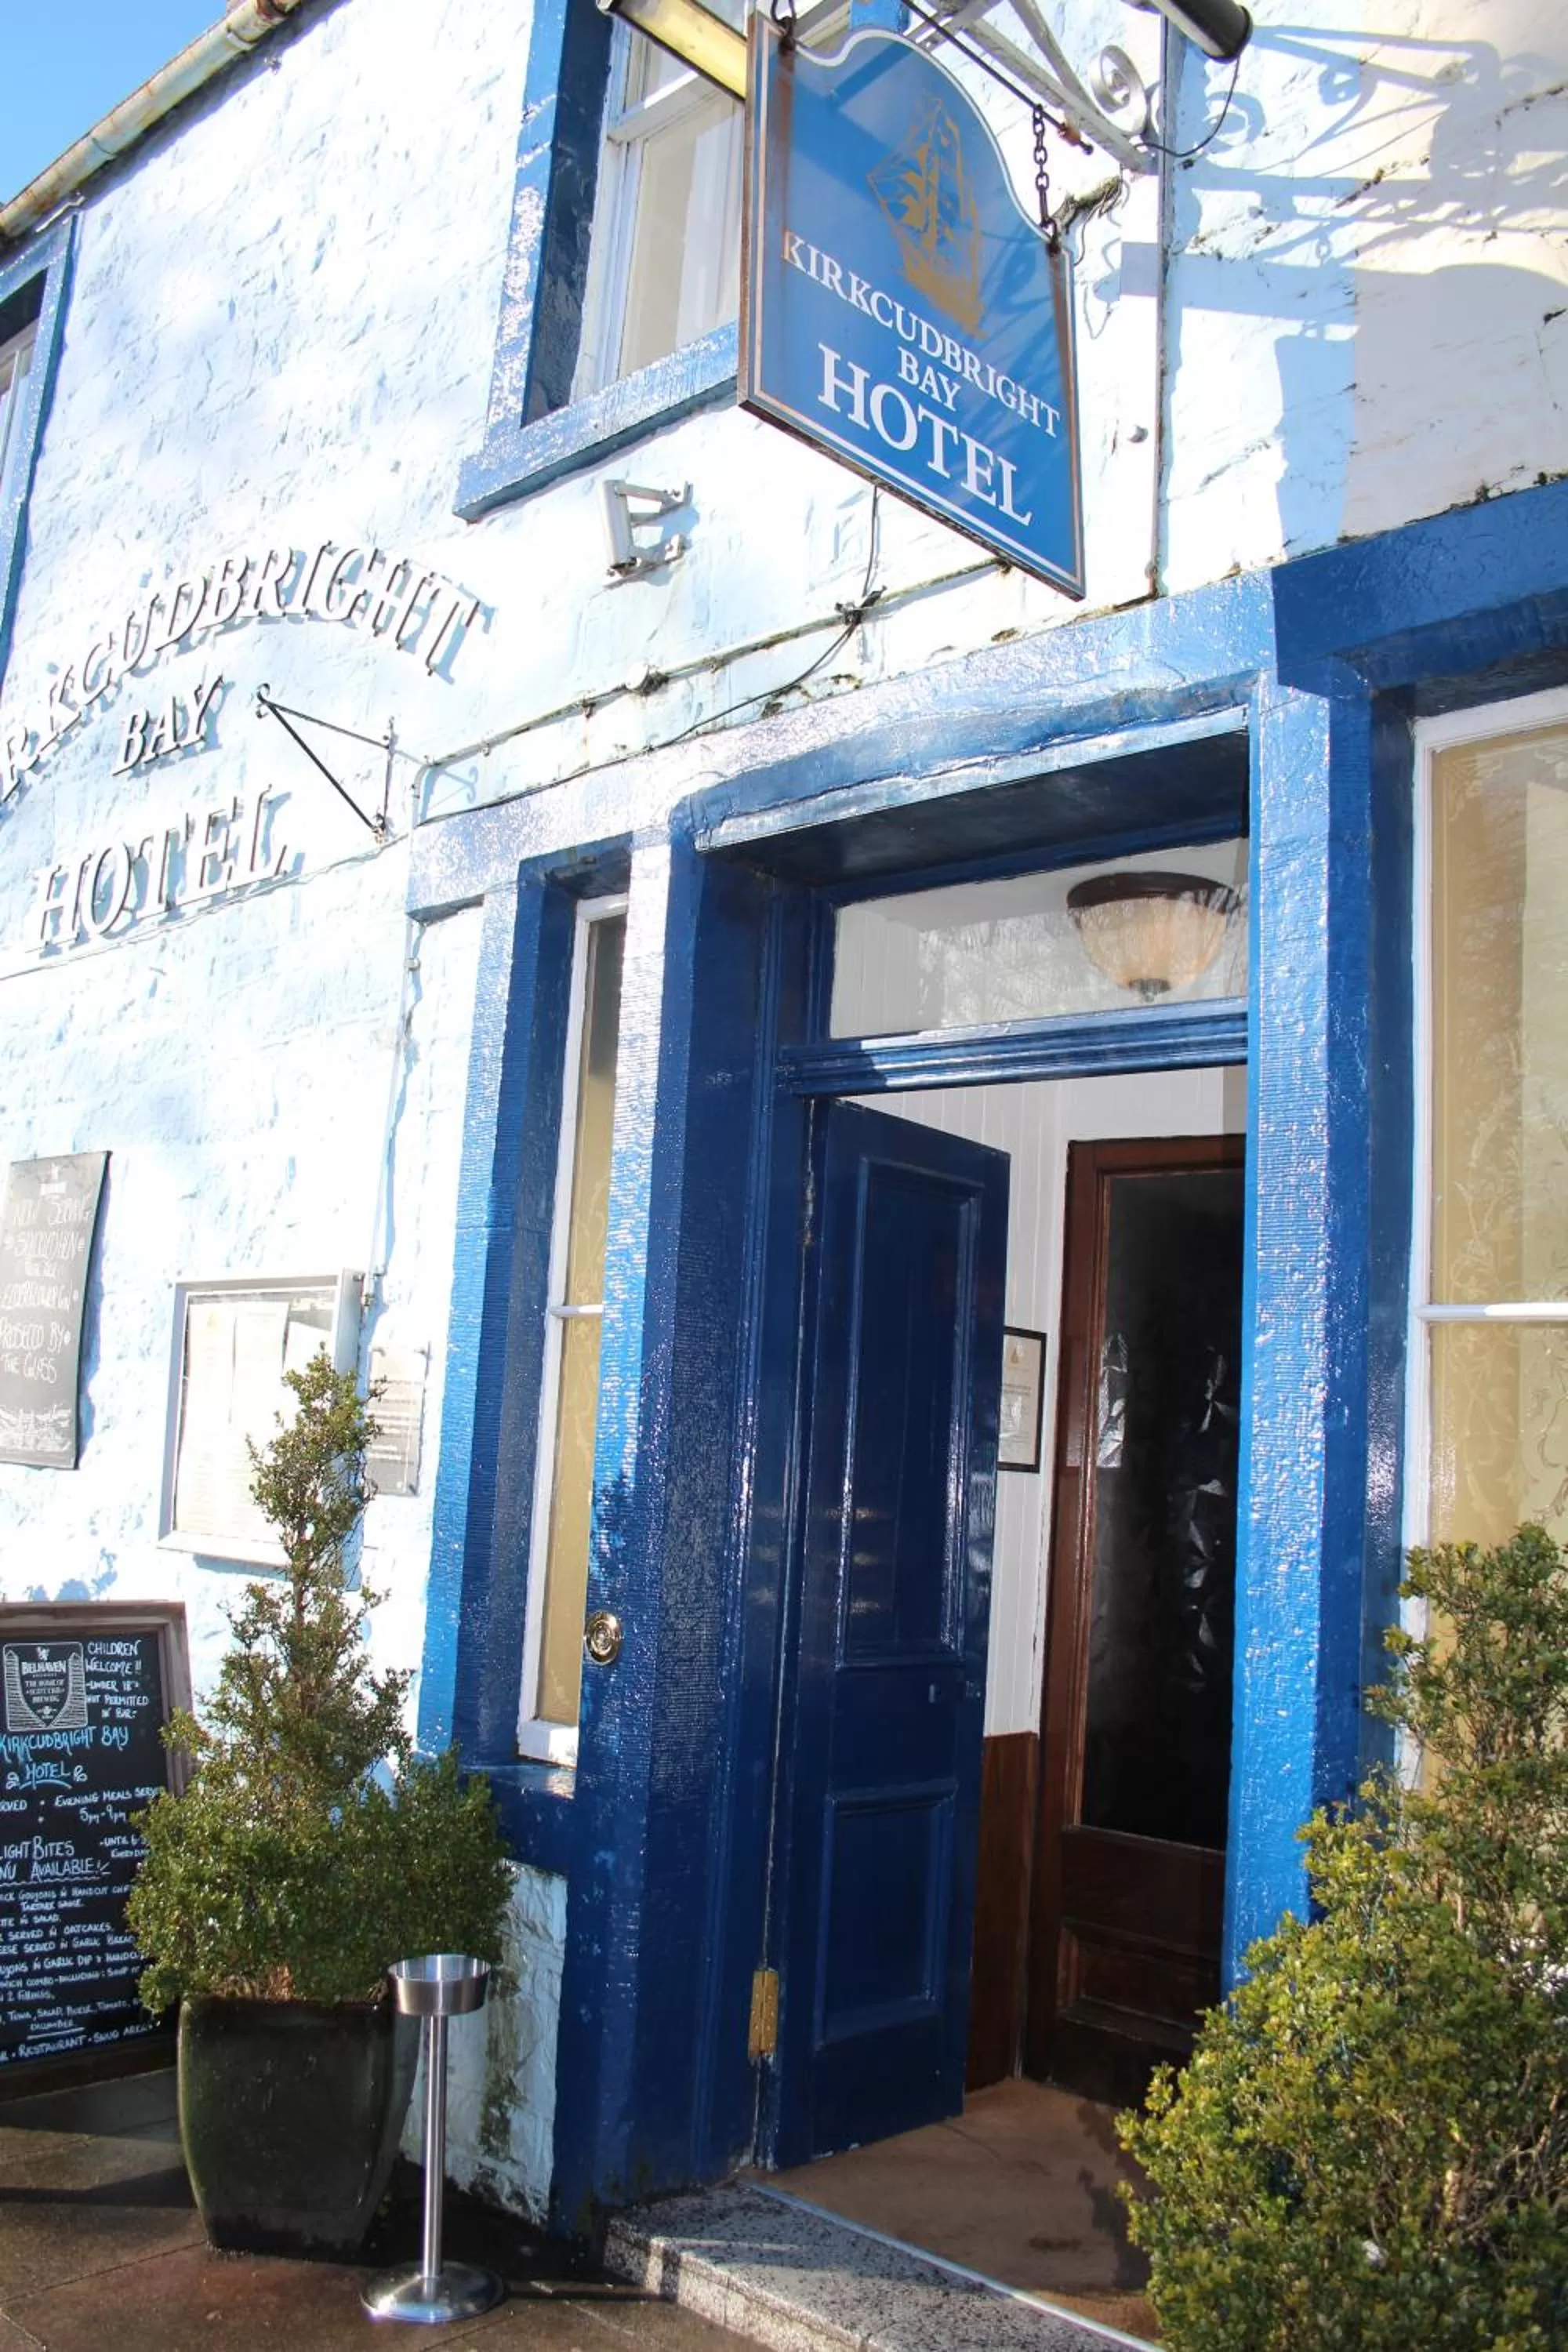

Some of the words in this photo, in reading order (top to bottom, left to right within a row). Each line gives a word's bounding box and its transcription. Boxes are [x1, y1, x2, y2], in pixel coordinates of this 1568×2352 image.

[783, 231, 1059, 437] KIRKCUDBRIGHT
[897, 346, 961, 412] BAY
[818, 343, 1033, 526] HOTEL
[113, 676, 227, 776] BAY
[26, 785, 296, 953] HOTEL
[88, 1639, 142, 1656] CHILDREN
[22, 1661, 67, 1675] BELHAVEN
[0, 1726, 96, 1764] KIRKCUDBRIGHT
[101, 1725, 129, 1751] BAY
[25, 1761, 71, 1791] HOTEL
[55, 1793, 99, 1806] EVENING
[103, 1790, 132, 1802] MEALS
[0, 1842, 31, 1860] IGHT
[33, 1835, 74, 1860] BITES
[8, 1929, 44, 1941] SERVED
[24, 1940, 56, 1953] SERVED
[18, 2034, 86, 2058] RESTAURANT
